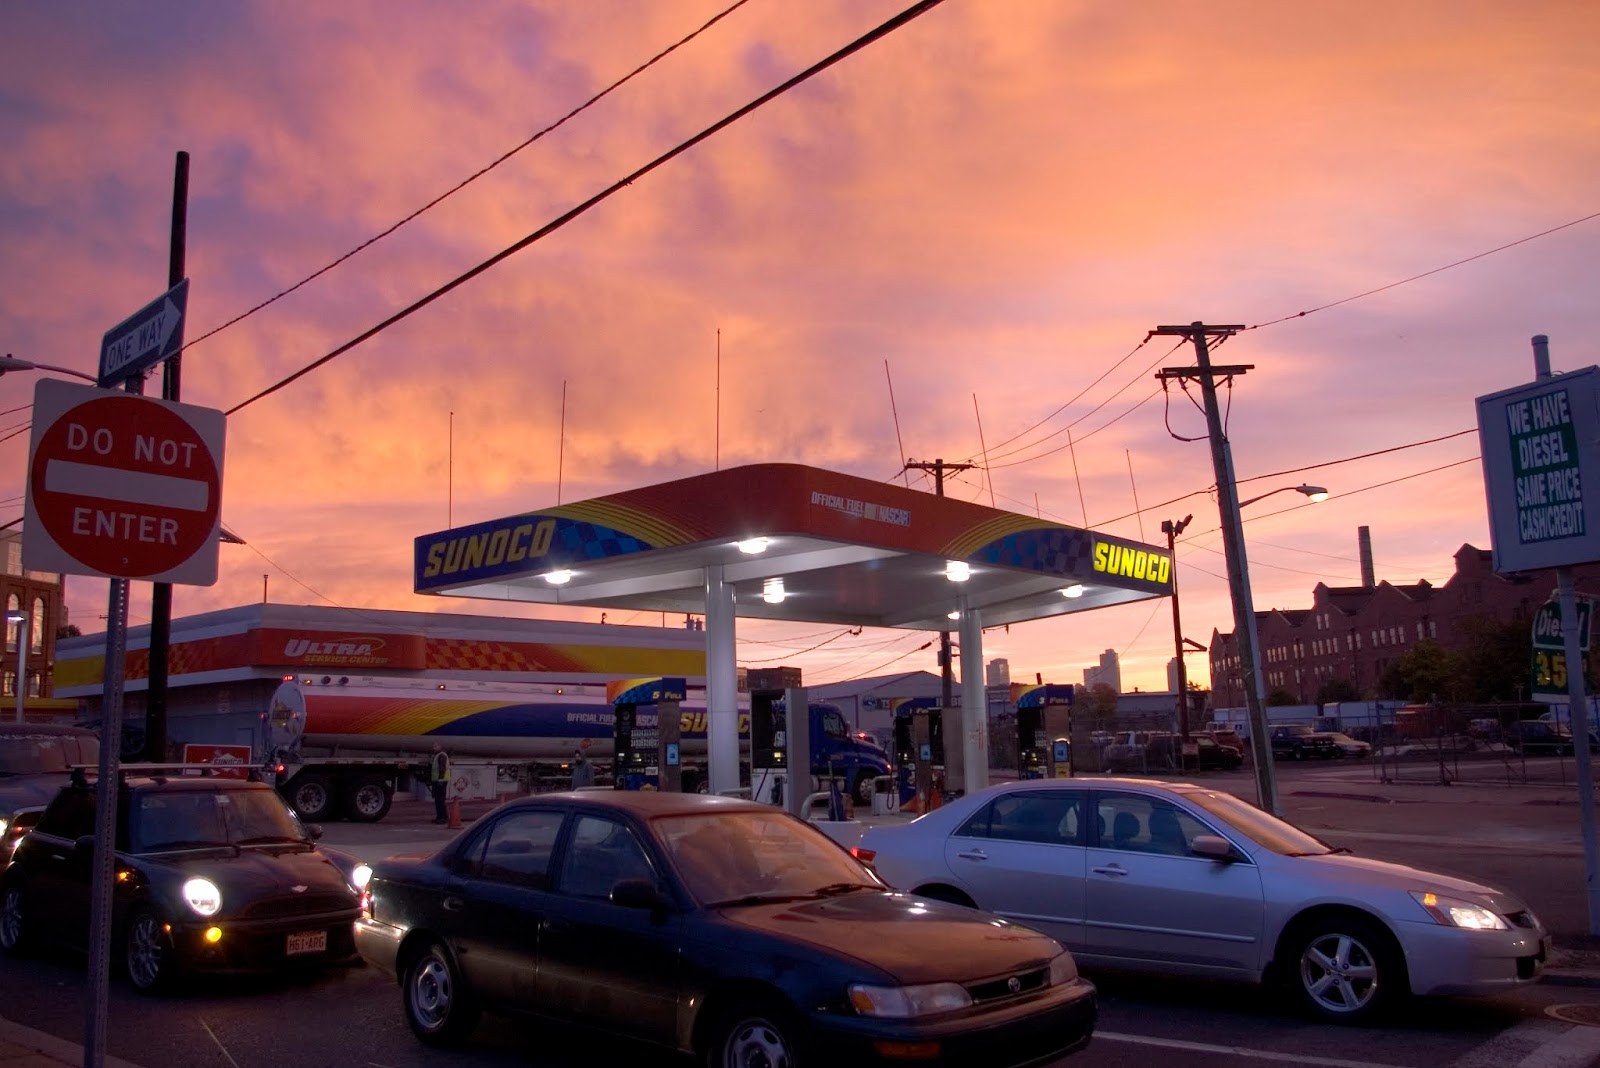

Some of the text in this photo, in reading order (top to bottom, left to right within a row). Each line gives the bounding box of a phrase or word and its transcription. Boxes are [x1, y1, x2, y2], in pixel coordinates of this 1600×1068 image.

[108, 313, 166, 370] ONE WAY
[1507, 391, 1570, 436] WE HAVE
[67, 423, 198, 468] DO NOT
[1518, 430, 1569, 470] DIESEL
[1516, 466, 1582, 509] SAME PRICE
[72, 506, 179, 546] ENTER
[811, 491, 910, 526] OFFICIAL FUEL NASCAR
[1519, 501, 1583, 541] CASH/CREDIT
[423, 519, 557, 578] SUNOCO
[1093, 541, 1170, 584] SUNOCO
[1536, 609, 1585, 638] Diel
[283, 639, 372, 657] ULTRA
[303, 654, 389, 664] SERVICE CENTER
[567, 713, 597, 722] OFFICIAL
[679, 712, 751, 733] SUC
